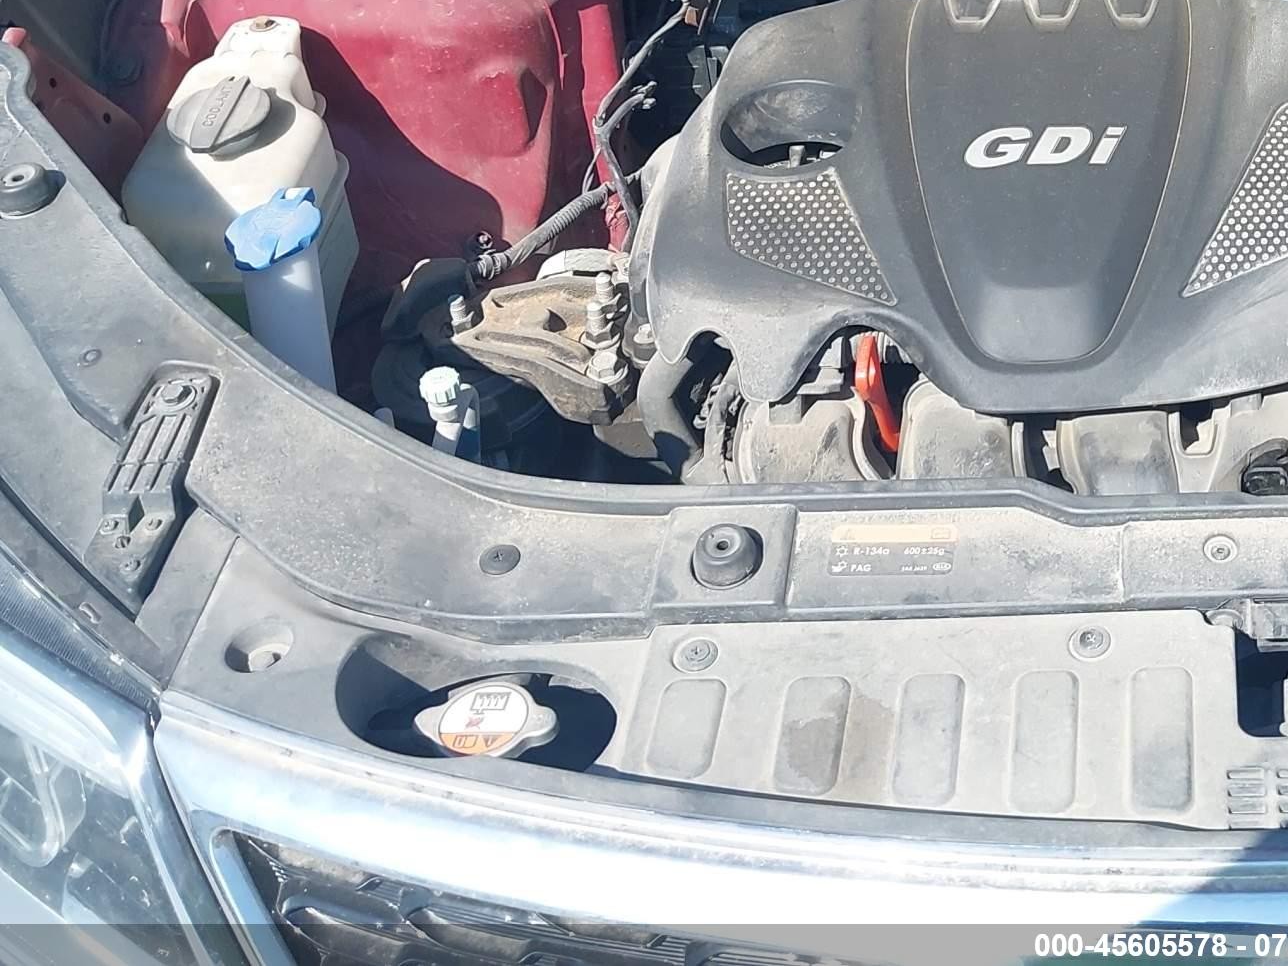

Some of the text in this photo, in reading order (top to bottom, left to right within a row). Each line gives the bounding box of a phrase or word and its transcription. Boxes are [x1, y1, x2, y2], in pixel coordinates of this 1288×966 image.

[202, 86, 232, 126] COOLANT
[964, 126, 1128, 168] GDi
[853, 546, 890, 555] R-134a
[851, 563, 872, 572] PAG
